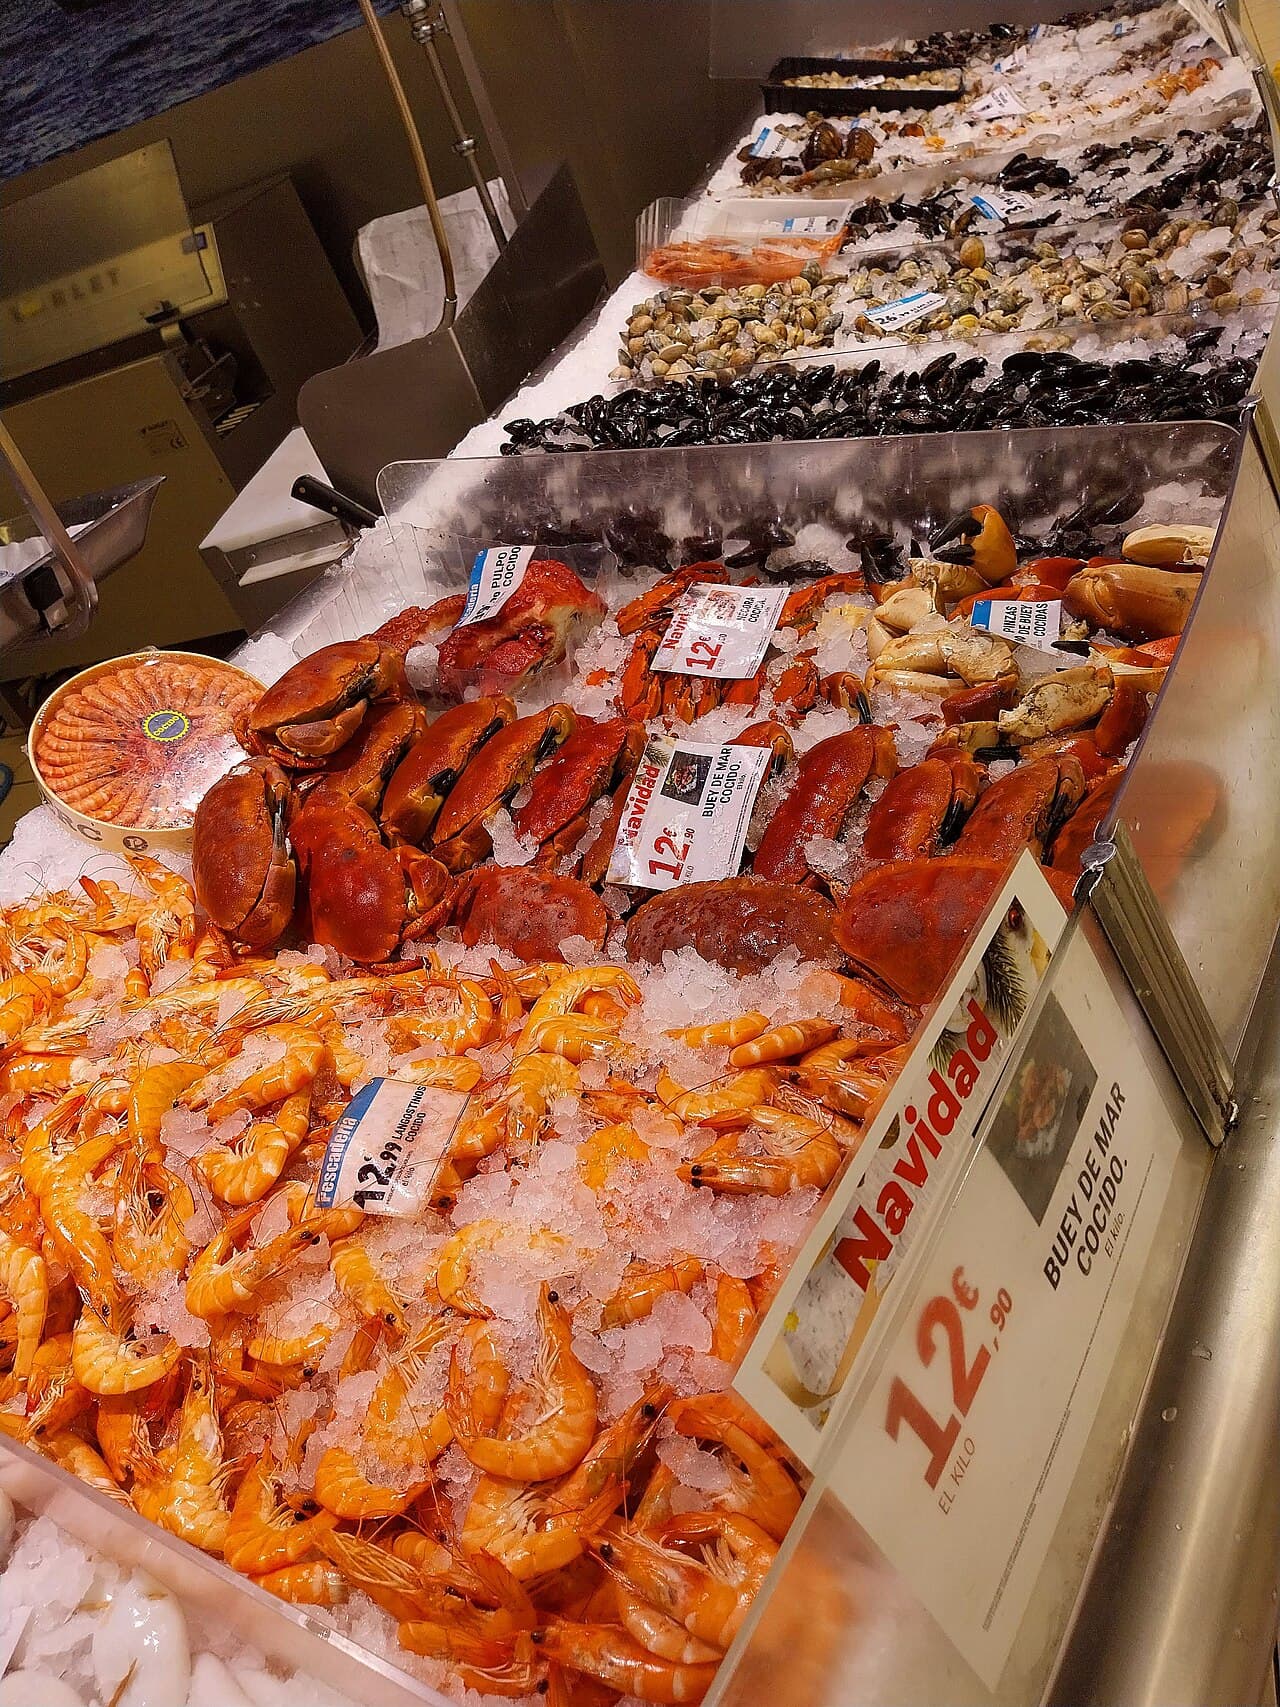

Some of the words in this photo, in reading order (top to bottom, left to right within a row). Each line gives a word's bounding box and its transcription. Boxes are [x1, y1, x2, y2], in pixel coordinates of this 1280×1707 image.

[492, 552, 508, 589] PULPO
[502, 546, 522, 587] COCIDO
[1003, 605, 1018, 633] PINZAS
[1018, 624, 1031, 635] DE
[1019, 604, 1033, 624] BUEY
[1034, 603, 1048, 637] COCIDAS
[716, 747, 733, 771] MAR
[713, 772, 725, 787] DE
[719, 760, 742, 804] COCIDO.
[702, 790, 719, 817] BUEY
[392, 1085, 427, 1140] LANGOSTINOS
[404, 1112, 427, 1143] COCIDO
[833, 999, 999, 1292] Navidad
[1043, 1192, 1083, 1292] BUEY
[1077, 1151, 1101, 1202] DE
[1093, 1081, 1127, 1157] MAR
[1077, 1154, 1128, 1277] COCIDO.
[1104, 1241, 1113, 1259] El
[1112, 1212, 1126, 1241] kilo.
[937, 1490, 956, 1516] EL
[950, 1437, 976, 1487] KILO
